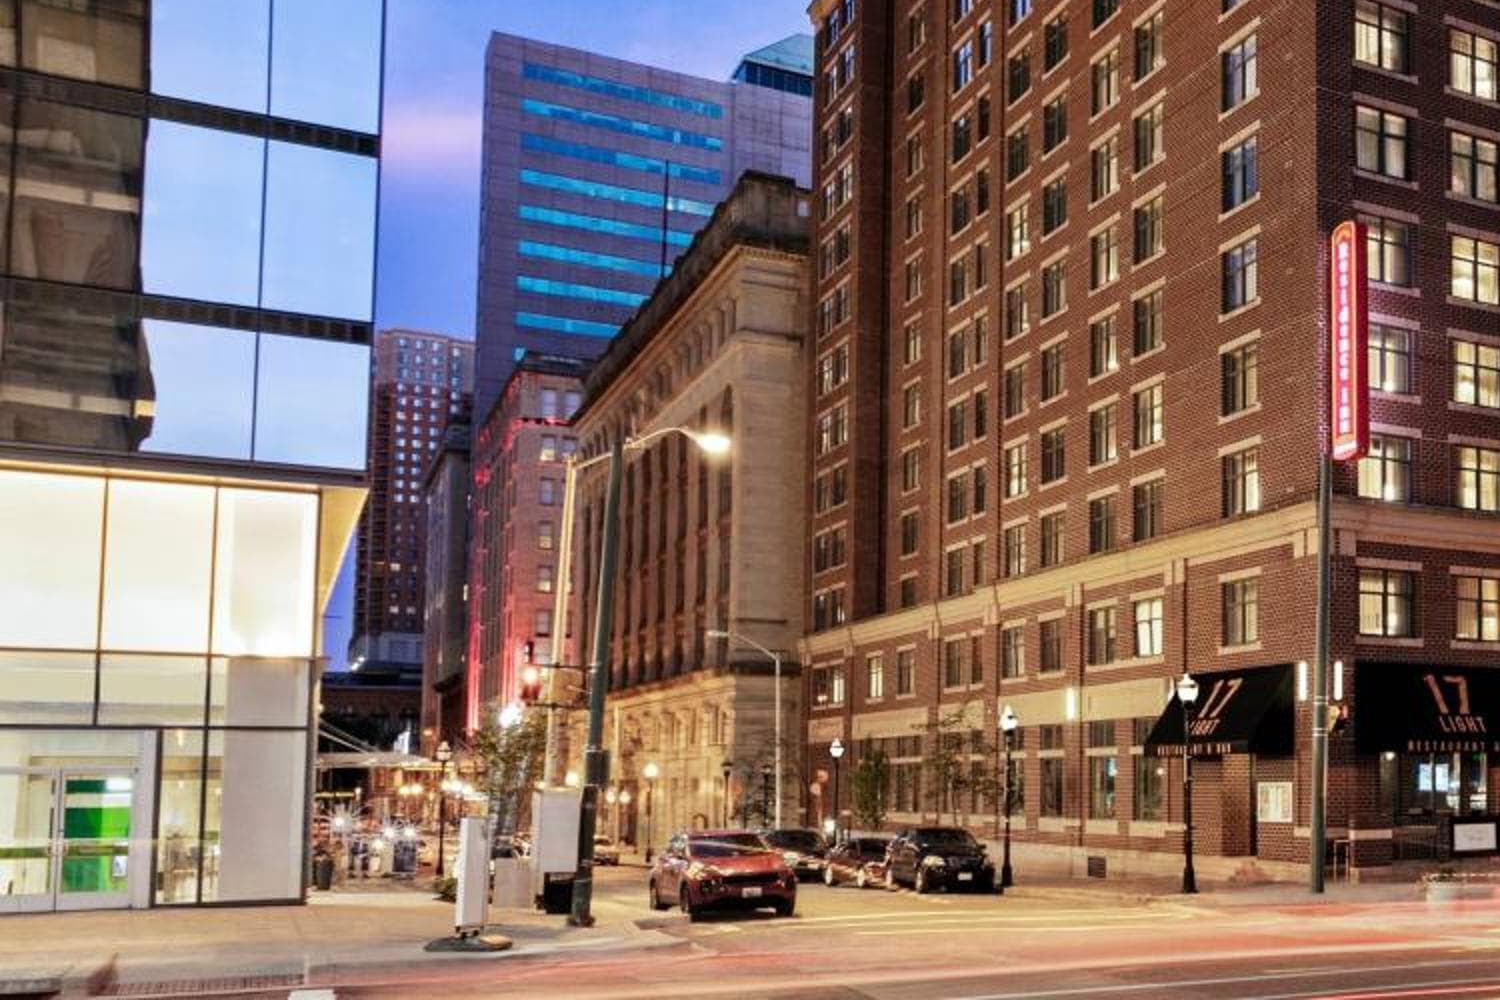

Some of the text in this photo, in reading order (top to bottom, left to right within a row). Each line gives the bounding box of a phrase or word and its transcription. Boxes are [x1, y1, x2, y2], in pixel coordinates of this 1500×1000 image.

[1198, 677, 1244, 718] 17
[1424, 674, 1470, 714] 17
[1439, 714, 1488, 733] LIGHT
[1408, 739, 1486, 753] RESTAURANT
